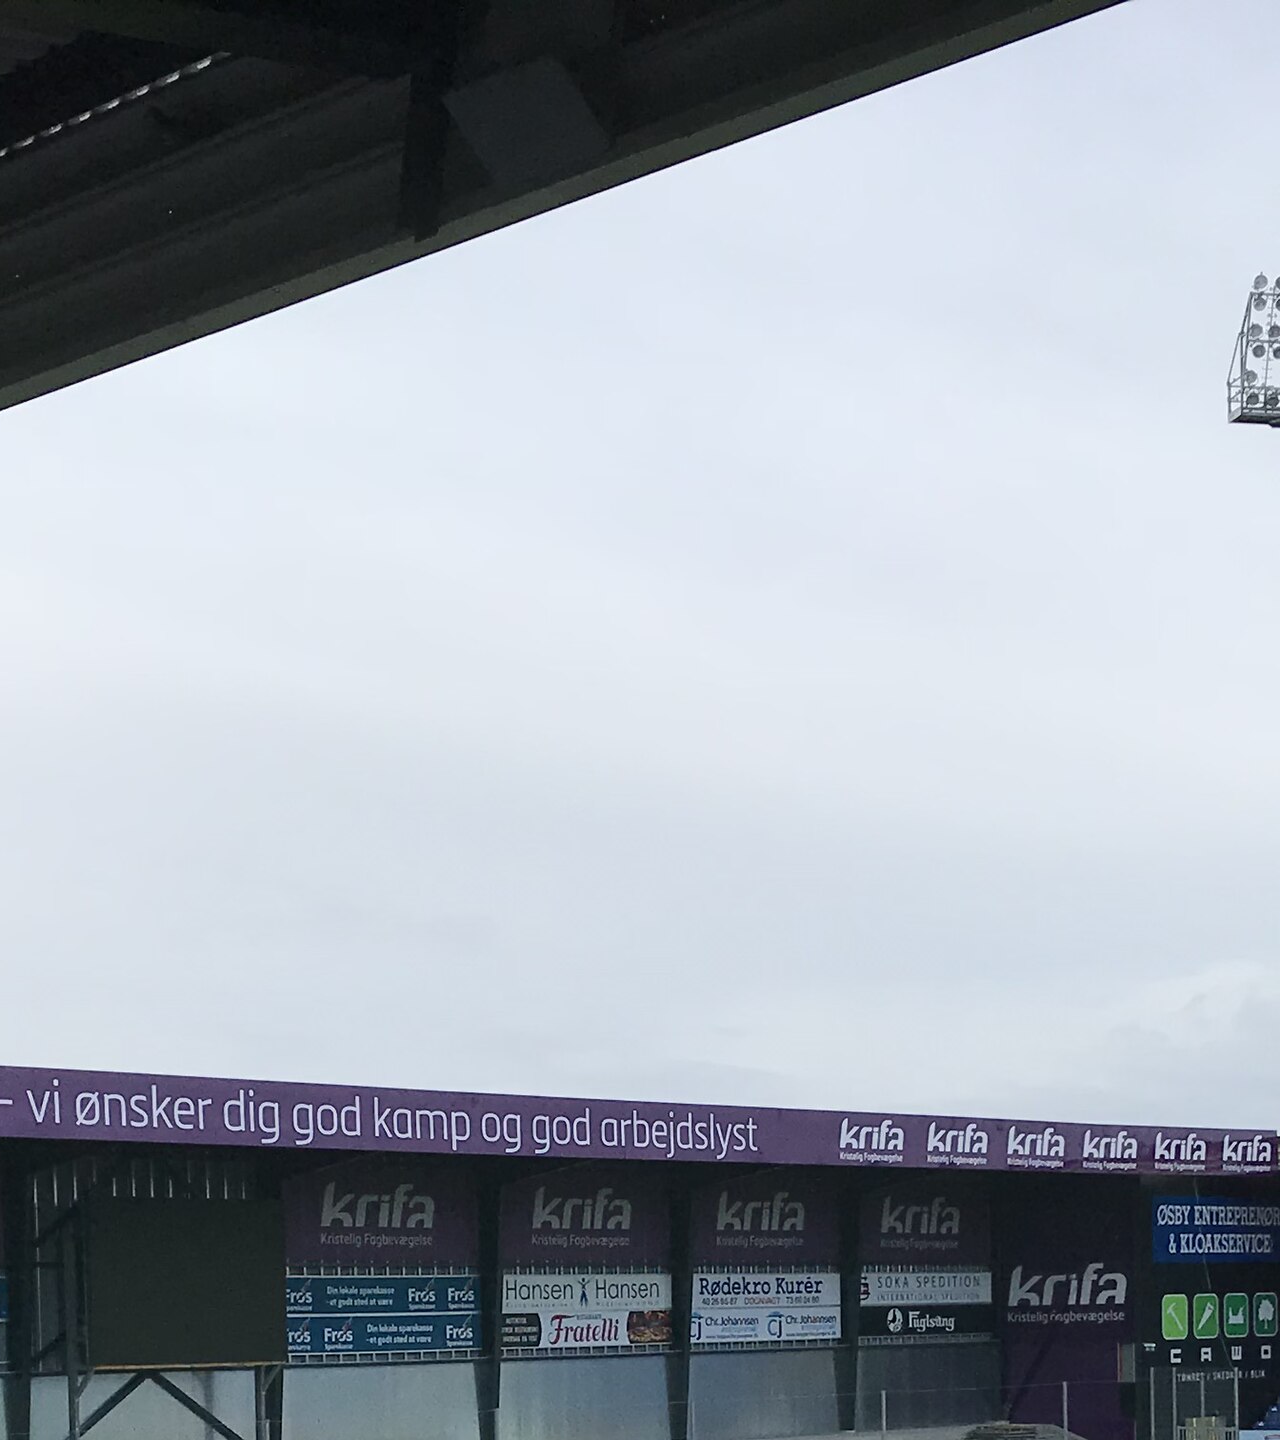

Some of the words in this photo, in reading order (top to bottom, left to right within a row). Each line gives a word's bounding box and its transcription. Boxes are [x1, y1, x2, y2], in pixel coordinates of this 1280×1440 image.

[26, 1079, 61, 1124] vi
[75, 1084, 212, 1131] ønsker
[223, 1089, 280, 1144] dig
[293, 1095, 362, 1146] god
[374, 1097, 471, 1151] kamp
[481, 1112, 522, 1153] og
[532, 1107, 591, 1154] god
[601, 1110, 759, 1160] arbejdslyst
[839, 1117, 905, 1150] krifa
[927, 1121, 989, 1154] krifa
[1007, 1124, 1065, 1157] krifa
[1082, 1129, 1138, 1160] krifa
[1154, 1132, 1207, 1161] krifa
[1223, 1134, 1272, 1162] krifa
[320, 1181, 435, 1229] krifa
[531, 1185, 632, 1230] krifa
[716, 1191, 805, 1231] krifa
[880, 1195, 961, 1235] krifa
[1156, 1204, 1191, 1226] ØSBY
[1179, 1233, 1272, 1254] KLOAKSERVICE
[505, 1279, 574, 1301] Hansen
[595, 1278, 660, 1299] Hansen
[698, 1276, 771, 1296] Rødekro
[775, 1276, 823, 1295] Kurér
[877, 1275, 910, 1289] SOKA
[915, 1275, 980, 1288] SPEDITION
[1007, 1262, 1128, 1307] krifa
[548, 1314, 620, 1345] Fratelli
